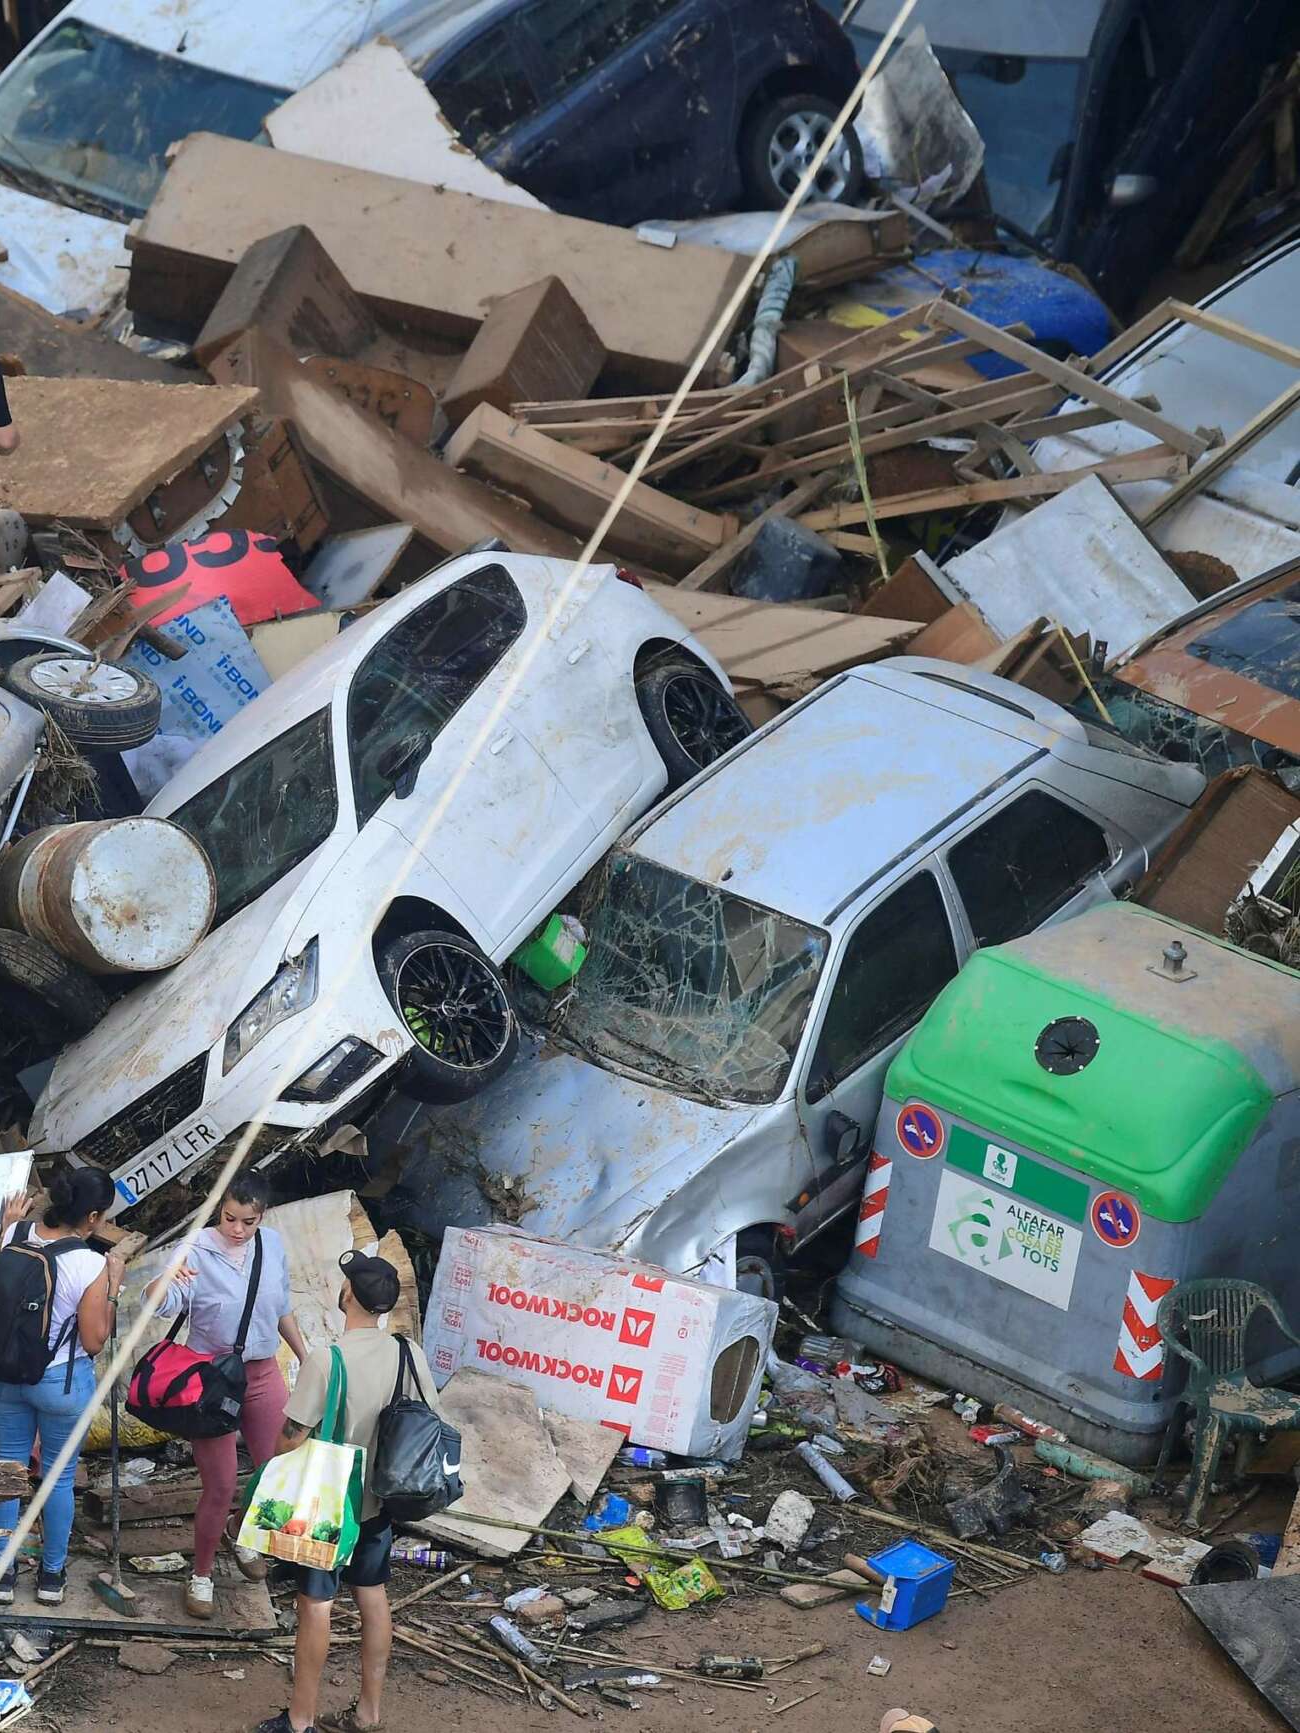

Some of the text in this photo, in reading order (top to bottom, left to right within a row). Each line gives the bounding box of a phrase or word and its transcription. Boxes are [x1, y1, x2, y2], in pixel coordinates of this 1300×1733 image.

[126, 1123, 217, 1196] 2717 LFR
[1006, 1204, 1065, 1238] ALFAFAR
[1017, 1219, 1044, 1240] NET
[1021, 1244, 1060, 1273] TOTS
[487, 1282, 617, 1331] ROCKWOOL
[476, 1338, 605, 1388] ROCKWOOL
